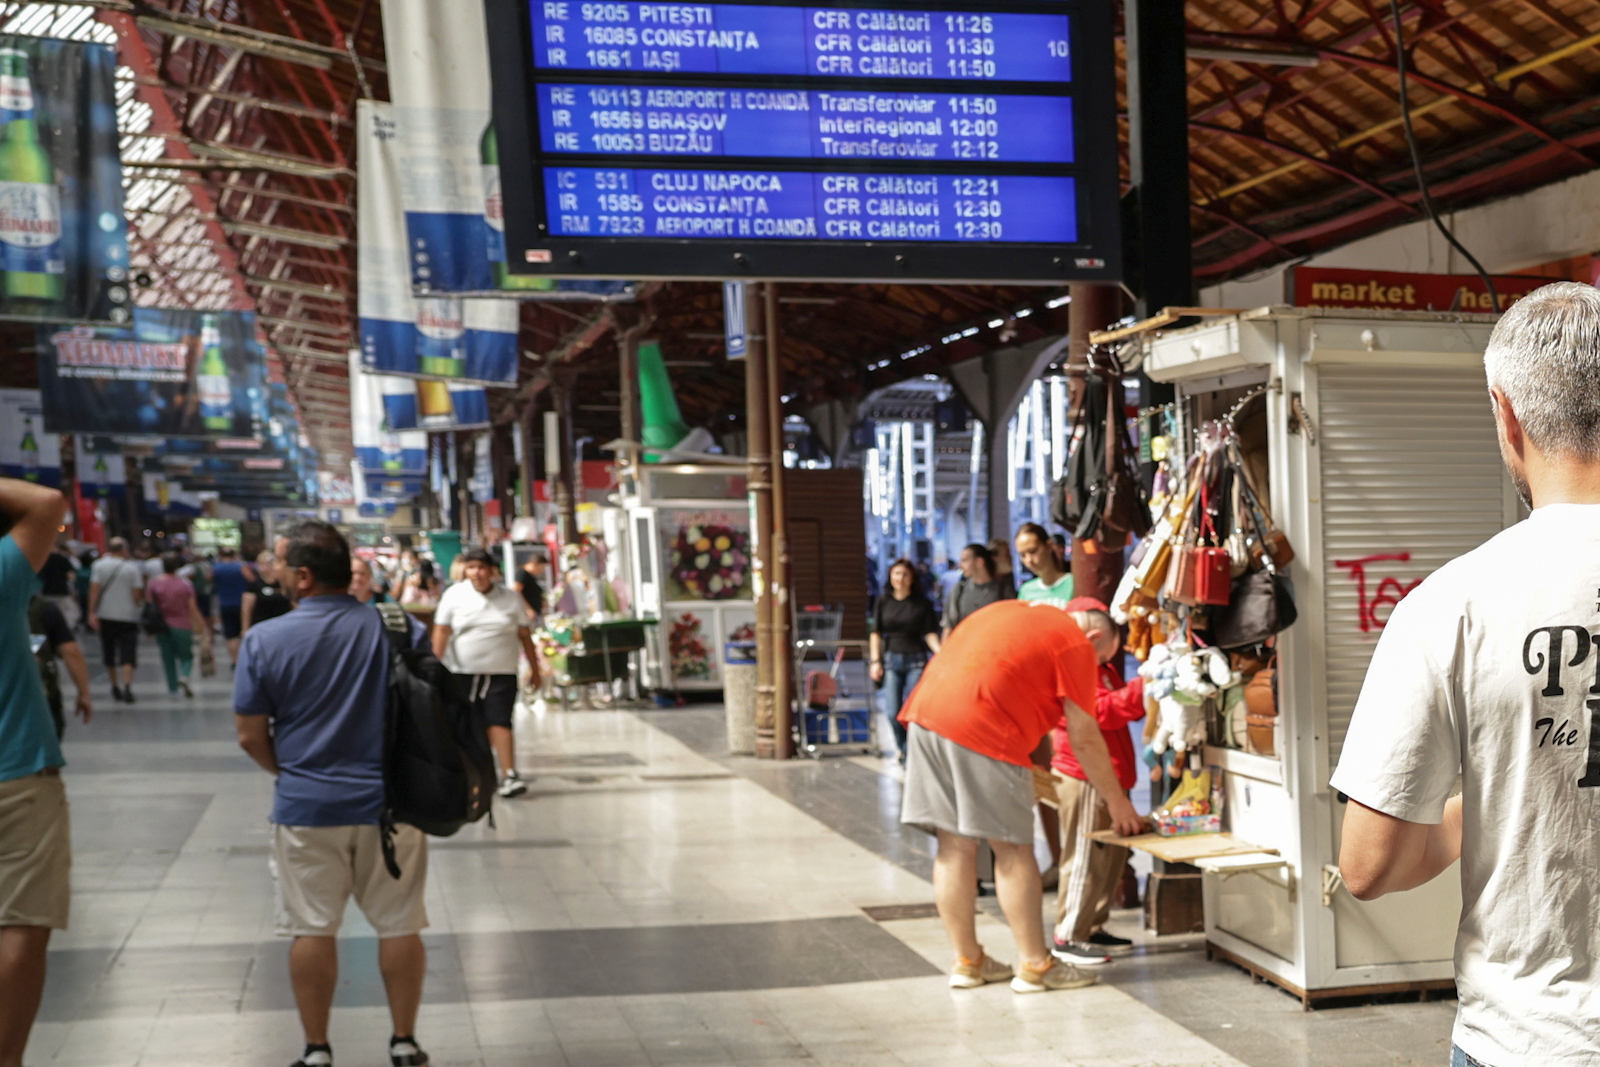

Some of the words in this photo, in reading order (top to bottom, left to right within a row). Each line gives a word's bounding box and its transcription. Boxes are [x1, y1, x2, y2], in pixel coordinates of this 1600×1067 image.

[543, 2, 570, 21] RE
[581, 4, 630, 22] 9205
[813, 11, 851, 30] CFR
[945, 15, 993, 33] 11:26
[545, 26, 565, 43] IR
[583, 27, 638, 46] 16085
[815, 34, 852, 52] CFR
[946, 37, 995, 56] 11:30
[1047, 40, 1069, 57] 10
[547, 48, 567, 66] IR
[586, 50, 631, 68] 1661
[816, 56, 853, 74] CFR
[947, 59, 996, 77] 11:50
[551, 88, 576, 106] RE
[588, 89, 642, 108] 10113
[646, 90, 726, 110] AEROPORT
[730, 92, 742, 109] H
[818, 94, 936, 113] Transferoviar
[948, 97, 997, 115] 11:50
[552, 110, 572, 128] IR
[590, 111, 644, 130] 16569
[820, 117, 942, 137] InterRegional
[949, 119, 998, 137] 12:00
[554, 132, 580, 151] RE
[591, 133, 645, 152] 10053
[821, 137, 938, 156] Transferoviar
[951, 140, 999, 158] 12:12
[557, 171, 577, 190] IC
[595, 172, 628, 190] 531
[651, 173, 698, 191] CLUJ
[703, 174, 782, 193] NAPOCA
[823, 176, 859, 193] CFR
[952, 179, 999, 196] 12:21
[559, 193, 578, 212] IR
[597, 194, 643, 213] 1585
[824, 198, 861, 215] CFR
[954, 200, 1001, 218] 12:30
[561, 215, 590, 234] RM
[598, 216, 645, 234] 7923
[656, 217, 735, 235] AEROPORT
[739, 219, 750, 235] H
[825, 219, 861, 236] CFR
[954, 221, 1002, 239] 12:30
[1312, 281, 1416, 305] market
[1461, 286, 1536, 309] hera
[1535, 718, 1578, 748] The
